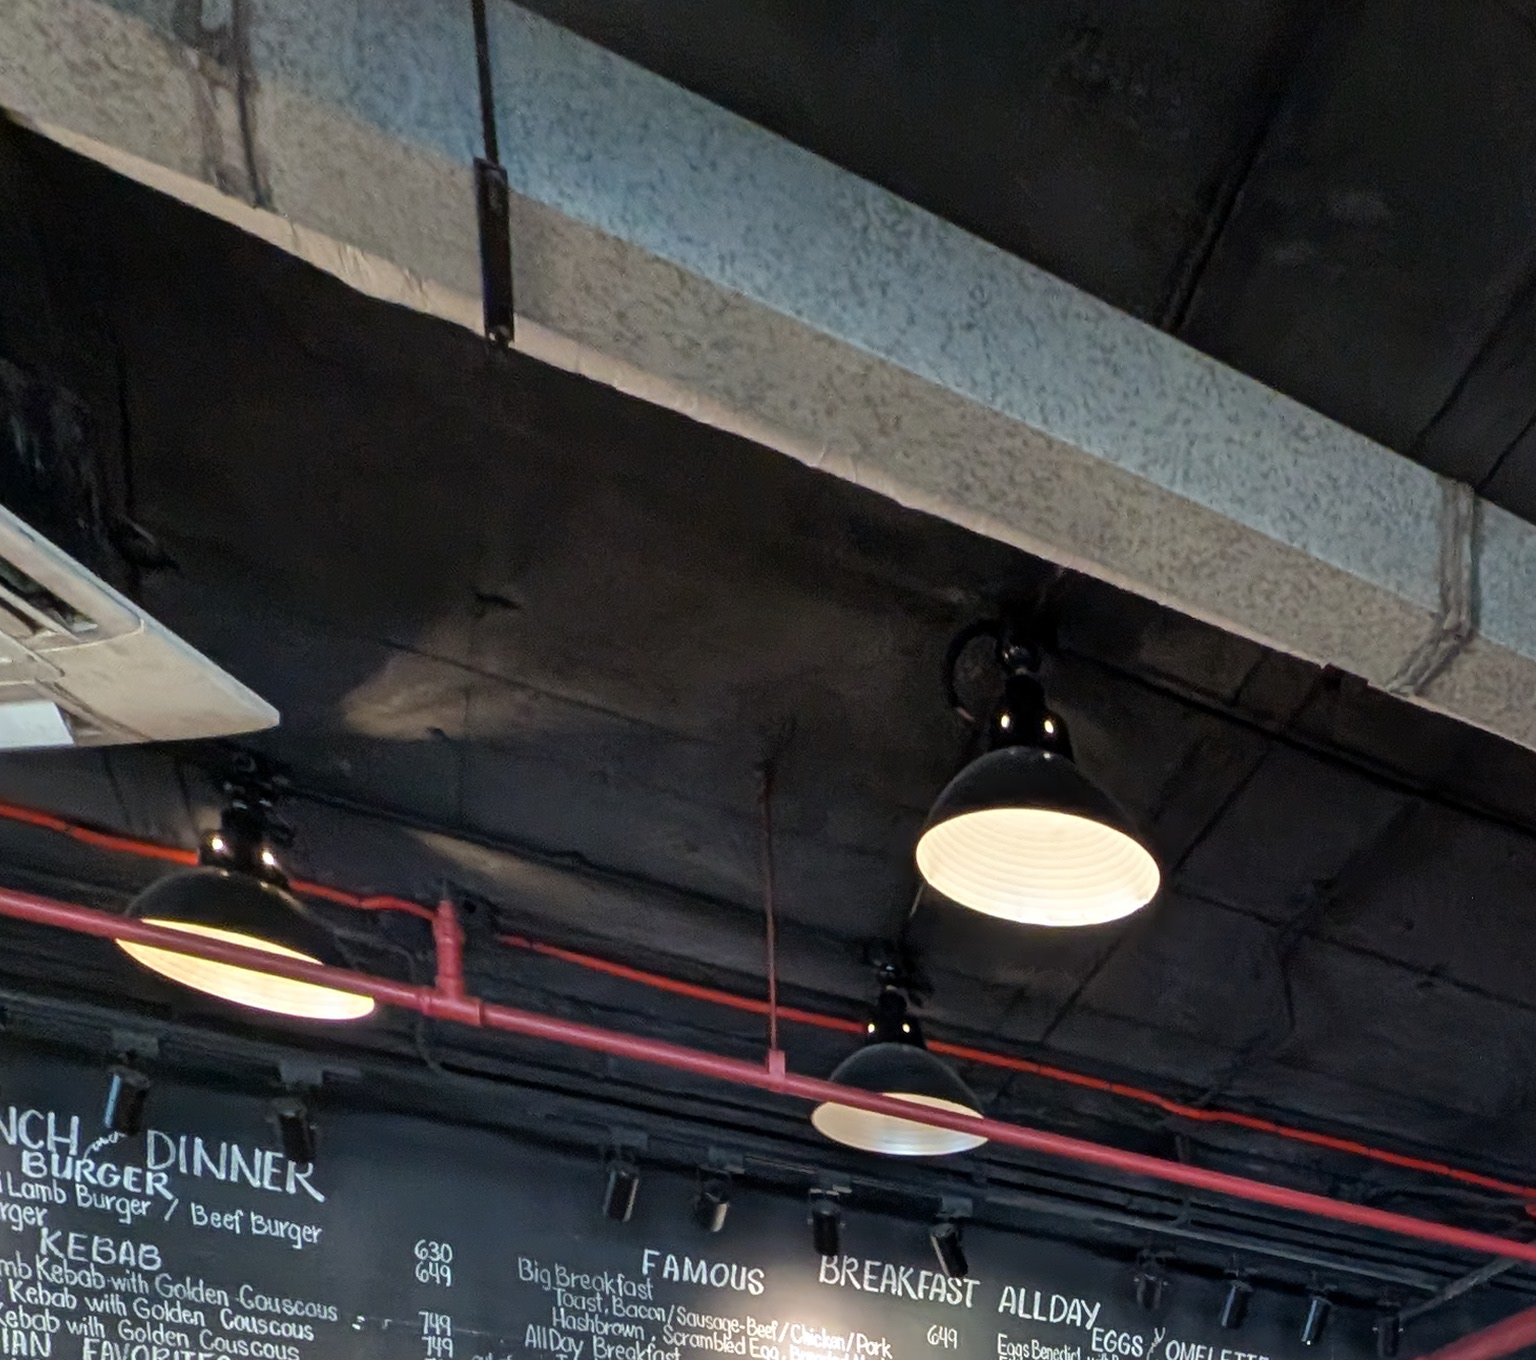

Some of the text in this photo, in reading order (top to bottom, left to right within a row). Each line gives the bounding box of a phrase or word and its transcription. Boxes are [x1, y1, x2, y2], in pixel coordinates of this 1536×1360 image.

[21, 1151, 175, 1199] BURGER
[146, 1130, 324, 1202] DINNER
[7, 1177, 453, 1262] Lamb Burger Beef Burger 630
[40, 1228, 162, 1270] KEBAB
[36, 1257, 452, 1336] Kebab with Golden Couscous 749
[518, 1256, 653, 1300] Big Breakfast
[641, 1249, 765, 1296] FAMOUS
[819, 1253, 981, 1308] BREAKFAST
[1092, 1328, 1144, 1357] EGGS
